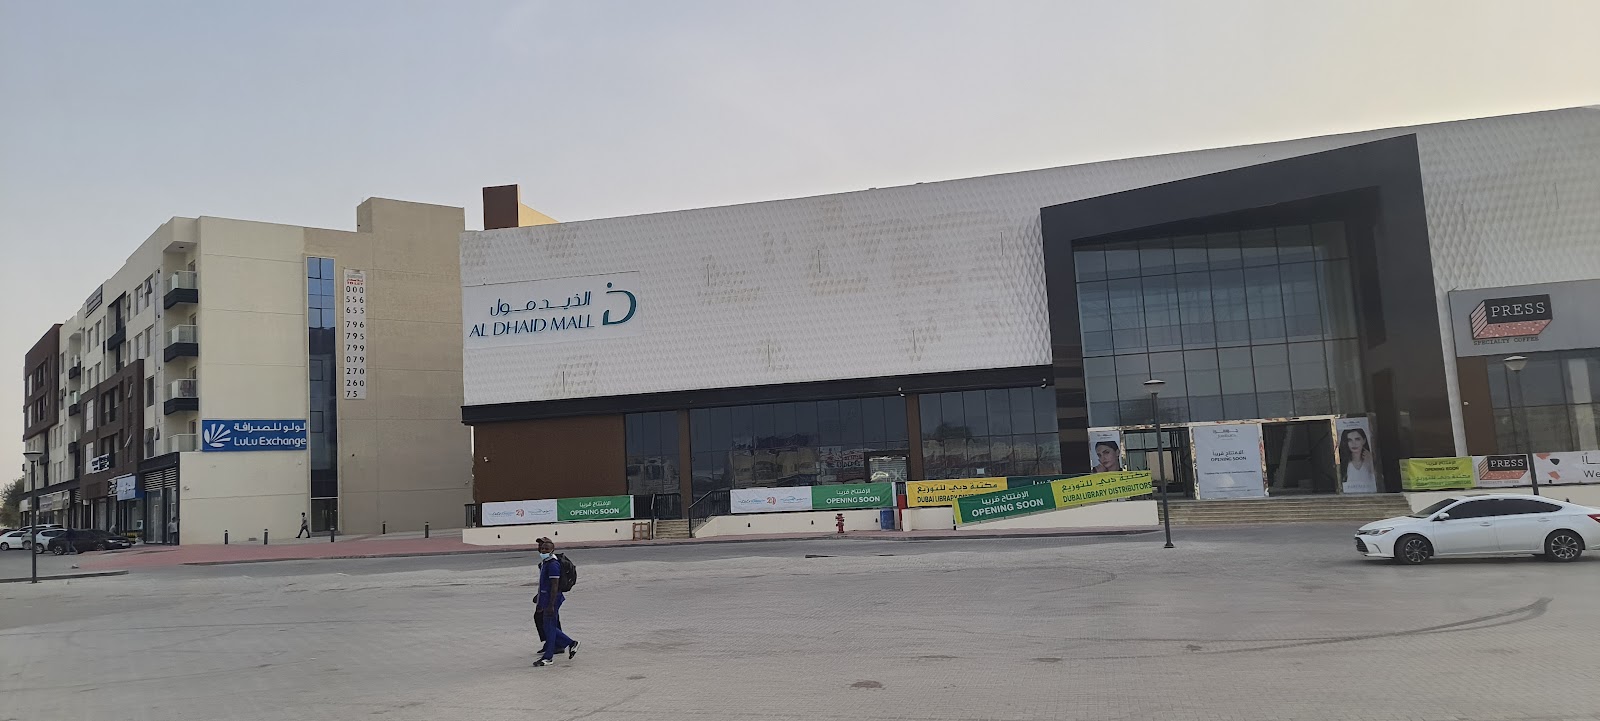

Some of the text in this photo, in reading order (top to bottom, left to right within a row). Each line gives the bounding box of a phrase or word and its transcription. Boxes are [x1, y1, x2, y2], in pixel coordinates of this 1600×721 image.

[490, 290, 592, 317] الذيد مول
[1490, 301, 1546, 318] PRESS
[468, 314, 595, 338] AL DHAID MALL
[1473, 335, 1540, 346] SPECIALTY COFFEE
[233, 422, 306, 434] لولو للصرافة
[259, 436, 307, 448] Exchange
[1490, 458, 1524, 468] PRESS
[1062, 482, 1152, 502] DUBAI LIBRARY DISTRIBUTORS
[826, 497, 858, 505] OPENING
[972, 498, 1044, 517] OPENING SOON
